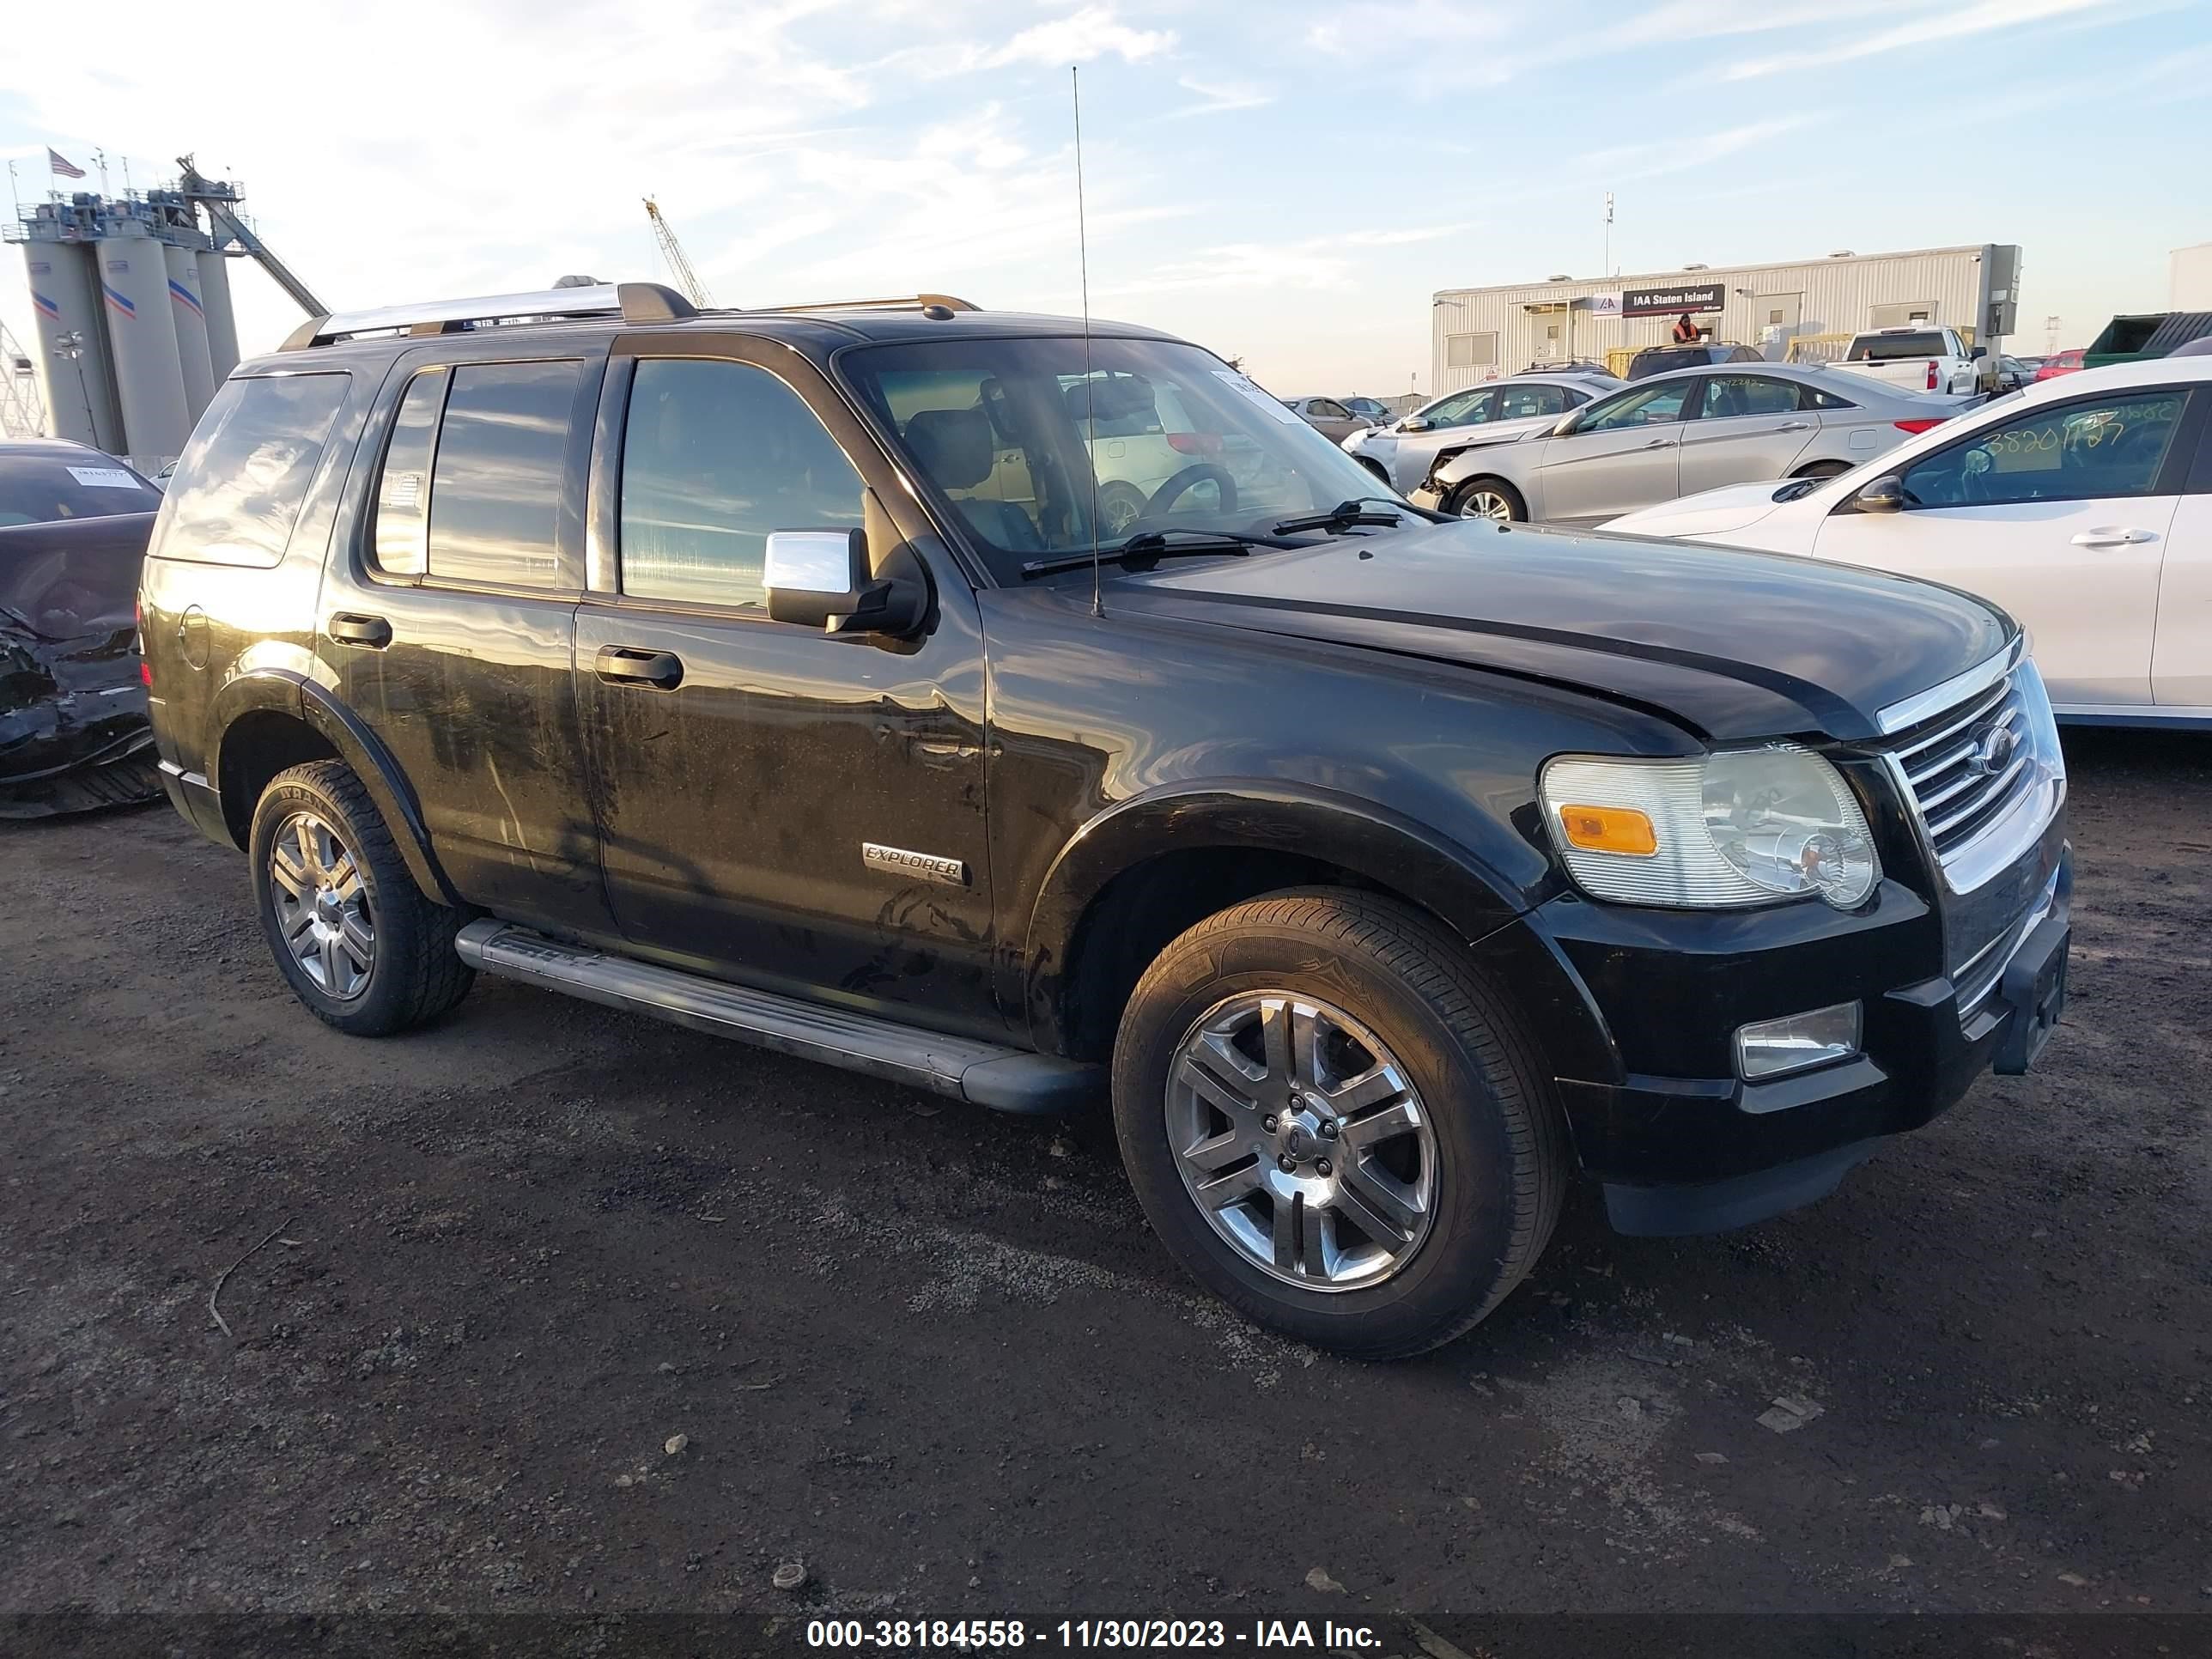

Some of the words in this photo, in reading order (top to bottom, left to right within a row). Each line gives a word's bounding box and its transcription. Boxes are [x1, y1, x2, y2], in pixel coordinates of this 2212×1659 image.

[1633, 295, 1651, 306] IAA
[1653, 294, 1682, 305] Staten
[1684, 290, 1714, 303] Island
[866, 847, 959, 875] EXPLORER
